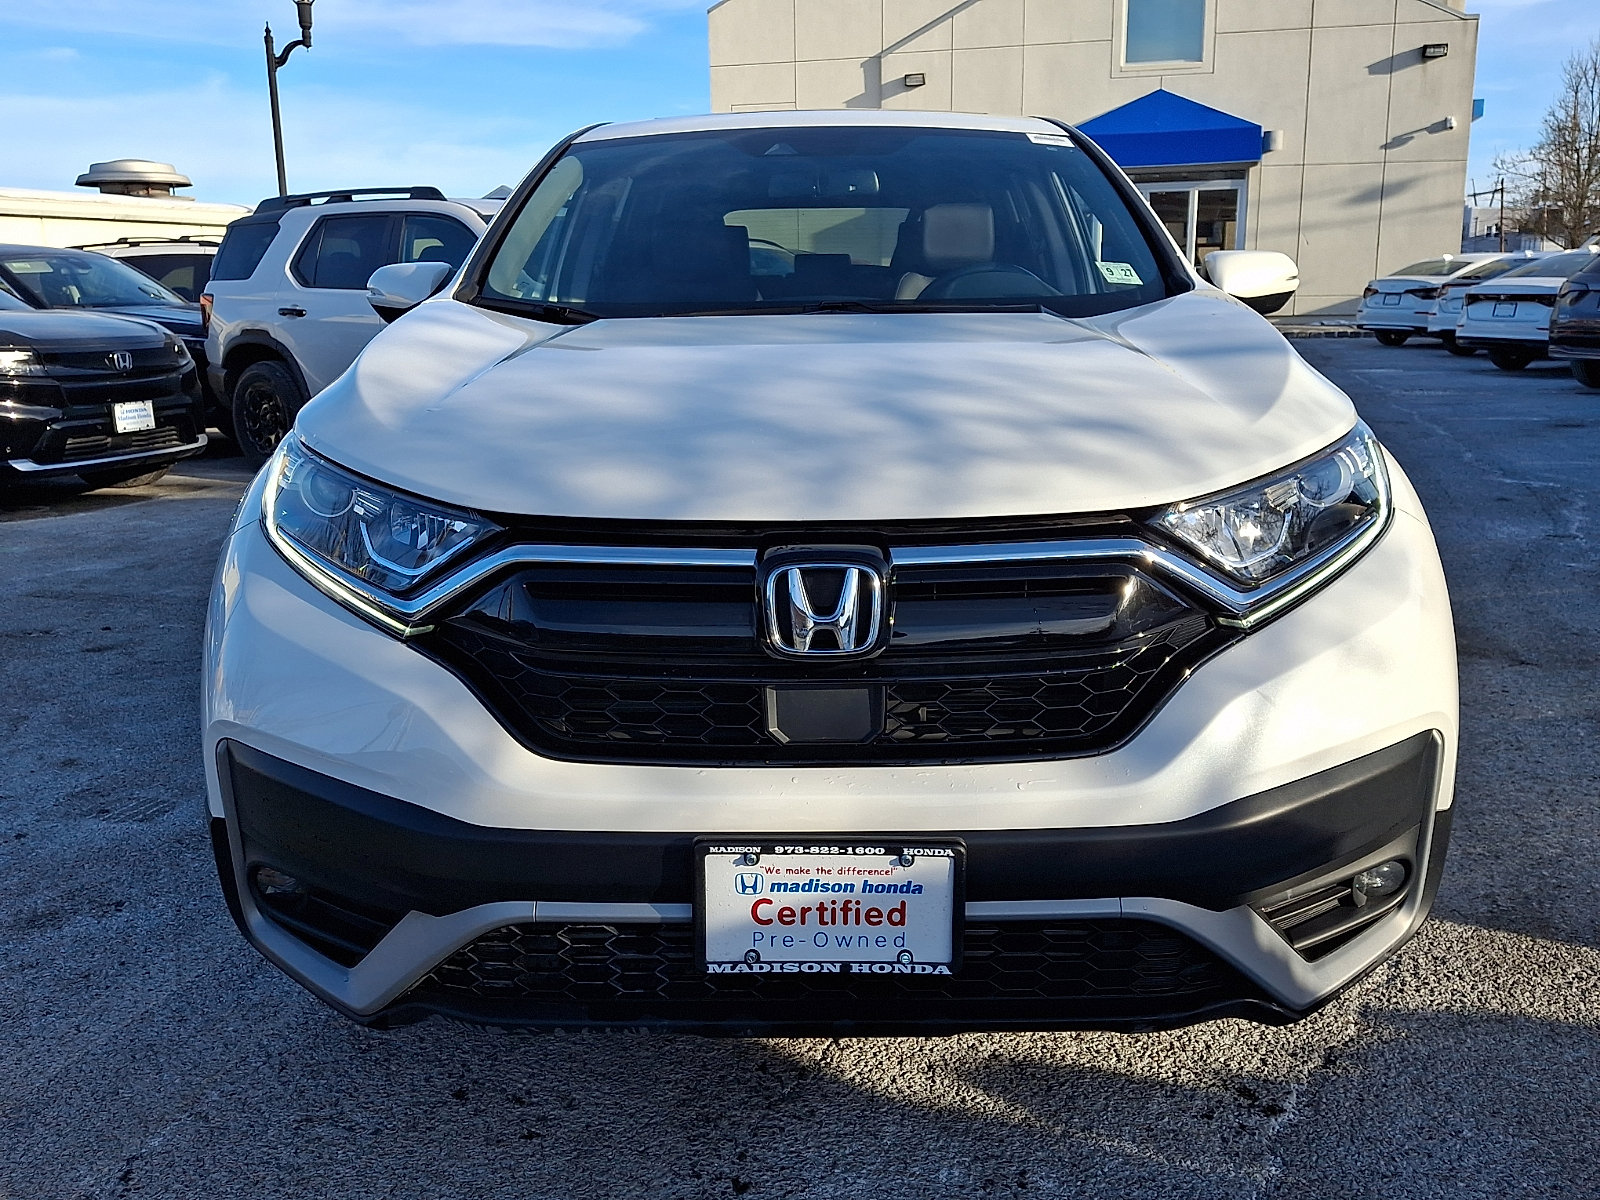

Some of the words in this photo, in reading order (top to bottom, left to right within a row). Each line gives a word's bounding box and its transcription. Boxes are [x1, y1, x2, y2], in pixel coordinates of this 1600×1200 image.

[1105, 267, 1114, 276] 9
[1120, 269, 1134, 277] 27
[774, 846, 885, 855] 973-822-1600
[902, 847, 955, 856] HONDA
[785, 867, 811, 875] make
[815, 866, 833, 876] the
[769, 879, 856, 893] madison
[861, 880, 924, 895] honda
[750, 898, 907, 927] Certified
[752, 931, 906, 948] Pre-Owned
[706, 963, 842, 974] MADISON
[849, 963, 952, 975] HONDA
